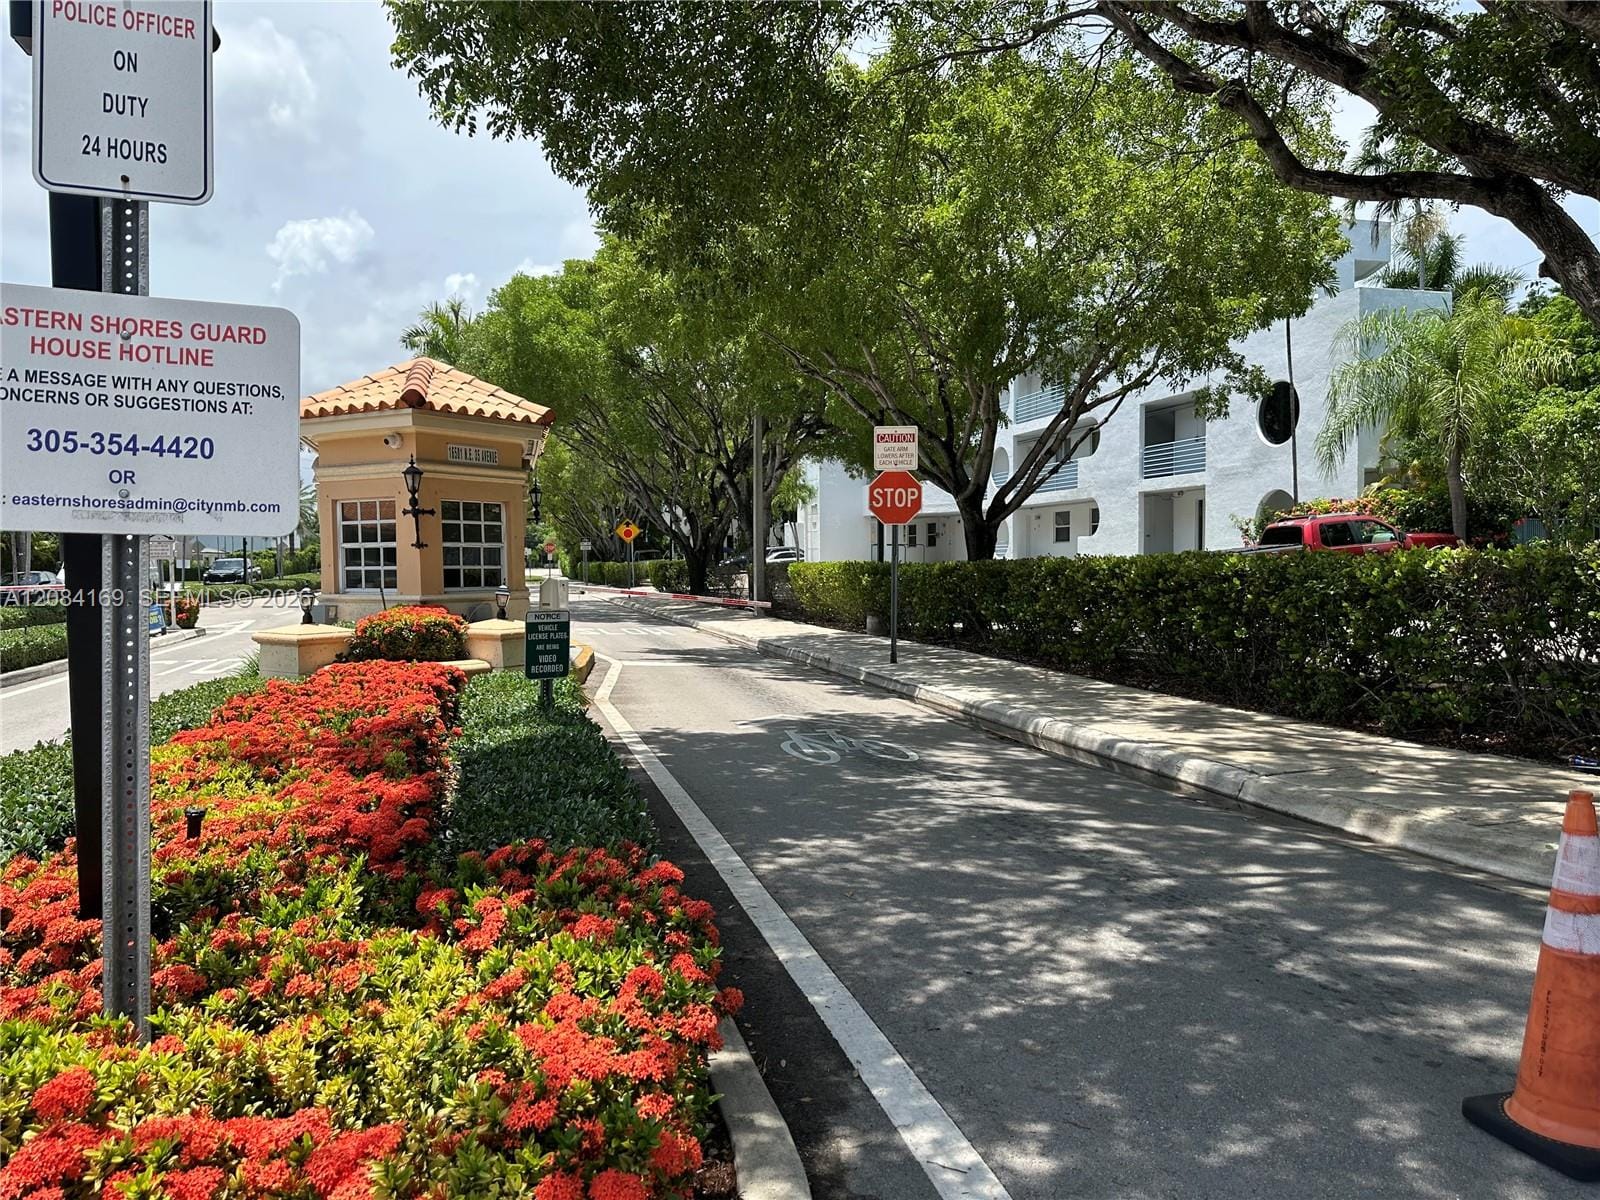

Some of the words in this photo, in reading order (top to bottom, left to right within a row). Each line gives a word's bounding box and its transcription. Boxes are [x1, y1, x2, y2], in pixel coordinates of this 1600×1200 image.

[53, 0, 116, 27] POLICE
[123, 10, 195, 39] OFFICER
[114, 50, 137, 73] ON
[103, 93, 148, 117] DUTY
[82, 135, 101, 156] 24
[107, 138, 167, 164] HOURS
[90, 315, 183, 339] SHORES
[190, 323, 266, 345] GUARD
[30, 335, 111, 360] HOUSE
[119, 344, 214, 367] HOTLINE
[7, 368, 19, 382] A
[24, 369, 106, 388] MESSAGE
[112, 376, 152, 391] WITH
[157, 379, 188, 394] ANY
[193, 381, 285, 400] QUESTIONS,
[85, 393, 109, 407] OR
[117, 395, 228, 414] SUGGESTIONS
[231, 402, 253, 415] AT:
[26, 428, 215, 459] 305-354-4420
[878, 434, 914, 442] CAUTION
[481, 449, 498, 463] AVENUE
[109, 470, 136, 484] OR
[12, 494, 280, 514] easternshoresadmin@citynmb.com
[872, 488, 918, 507] STOP
[531, 664, 564, 673] RECORDED
[538, 654, 557, 663] VIDEO
